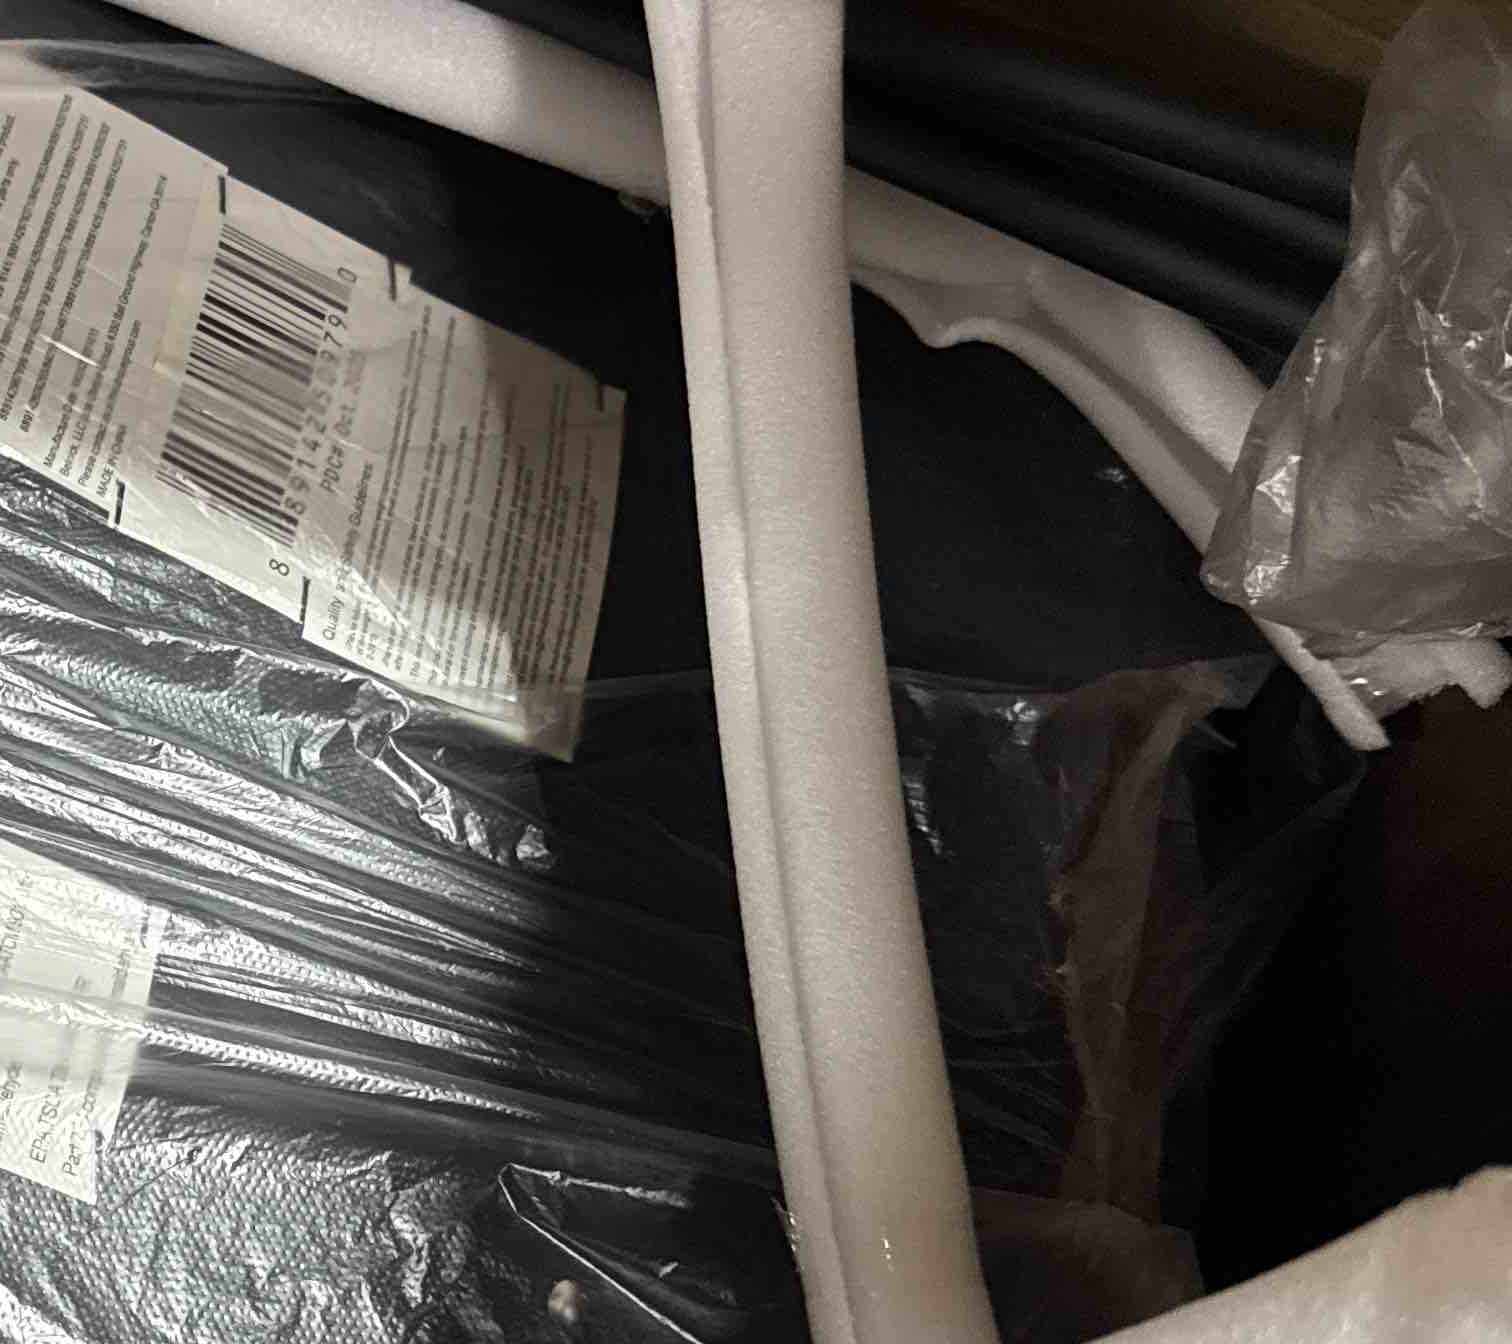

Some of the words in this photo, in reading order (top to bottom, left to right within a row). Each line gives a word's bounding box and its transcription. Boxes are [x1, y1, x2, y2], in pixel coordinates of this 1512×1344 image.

[71, 420, 88, 442] LLC
[117, 272, 137, 305] Ground
[266, 557, 292, 577] 8
[335, 265, 359, 284] 0
[108, 422, 129, 455] CHINA
[77, 454, 98, 487] Please
[105, 453, 119, 466] IN
[94, 464, 115, 498] MADE
[317, 595, 347, 642] Quality
[344, 460, 381, 529] Guidelines
